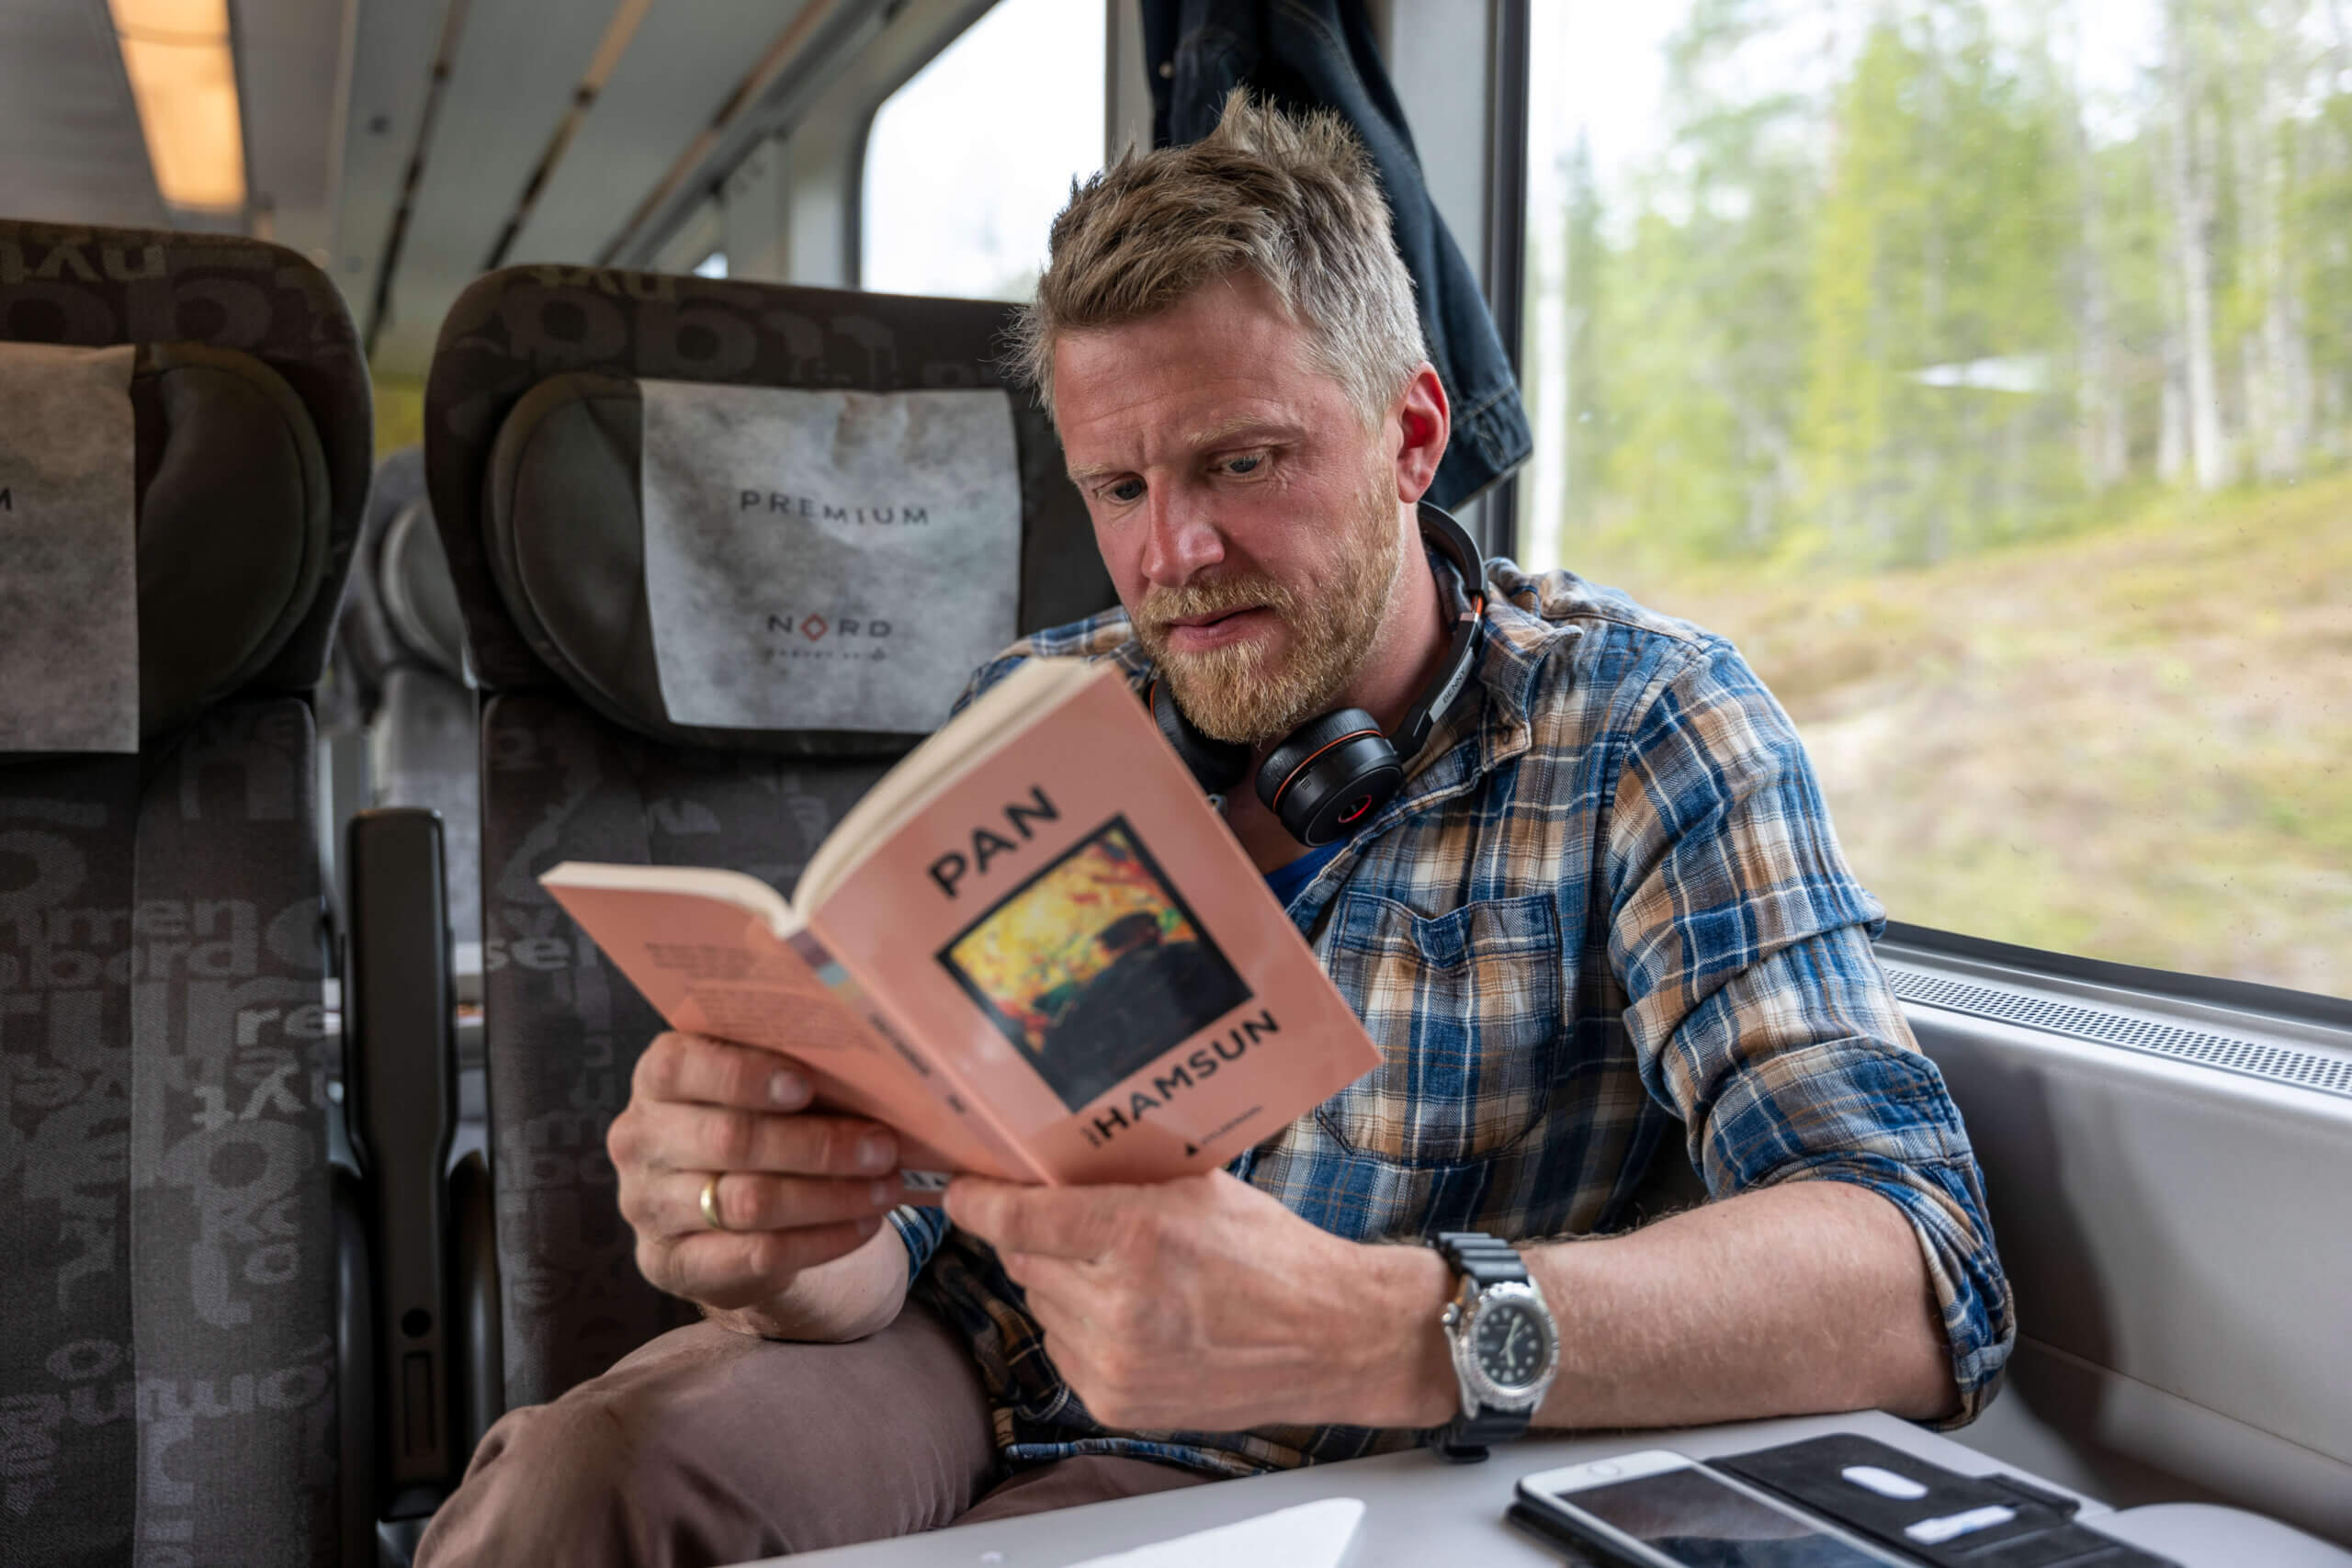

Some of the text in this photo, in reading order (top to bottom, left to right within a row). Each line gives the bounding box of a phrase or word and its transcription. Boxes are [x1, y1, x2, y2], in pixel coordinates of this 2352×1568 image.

[740, 489, 929, 526] PREMIUM
[767, 612, 892, 643] NORD
[928, 784, 1061, 899] PAN
[1091, 1008, 1281, 1140] HAMSUN
